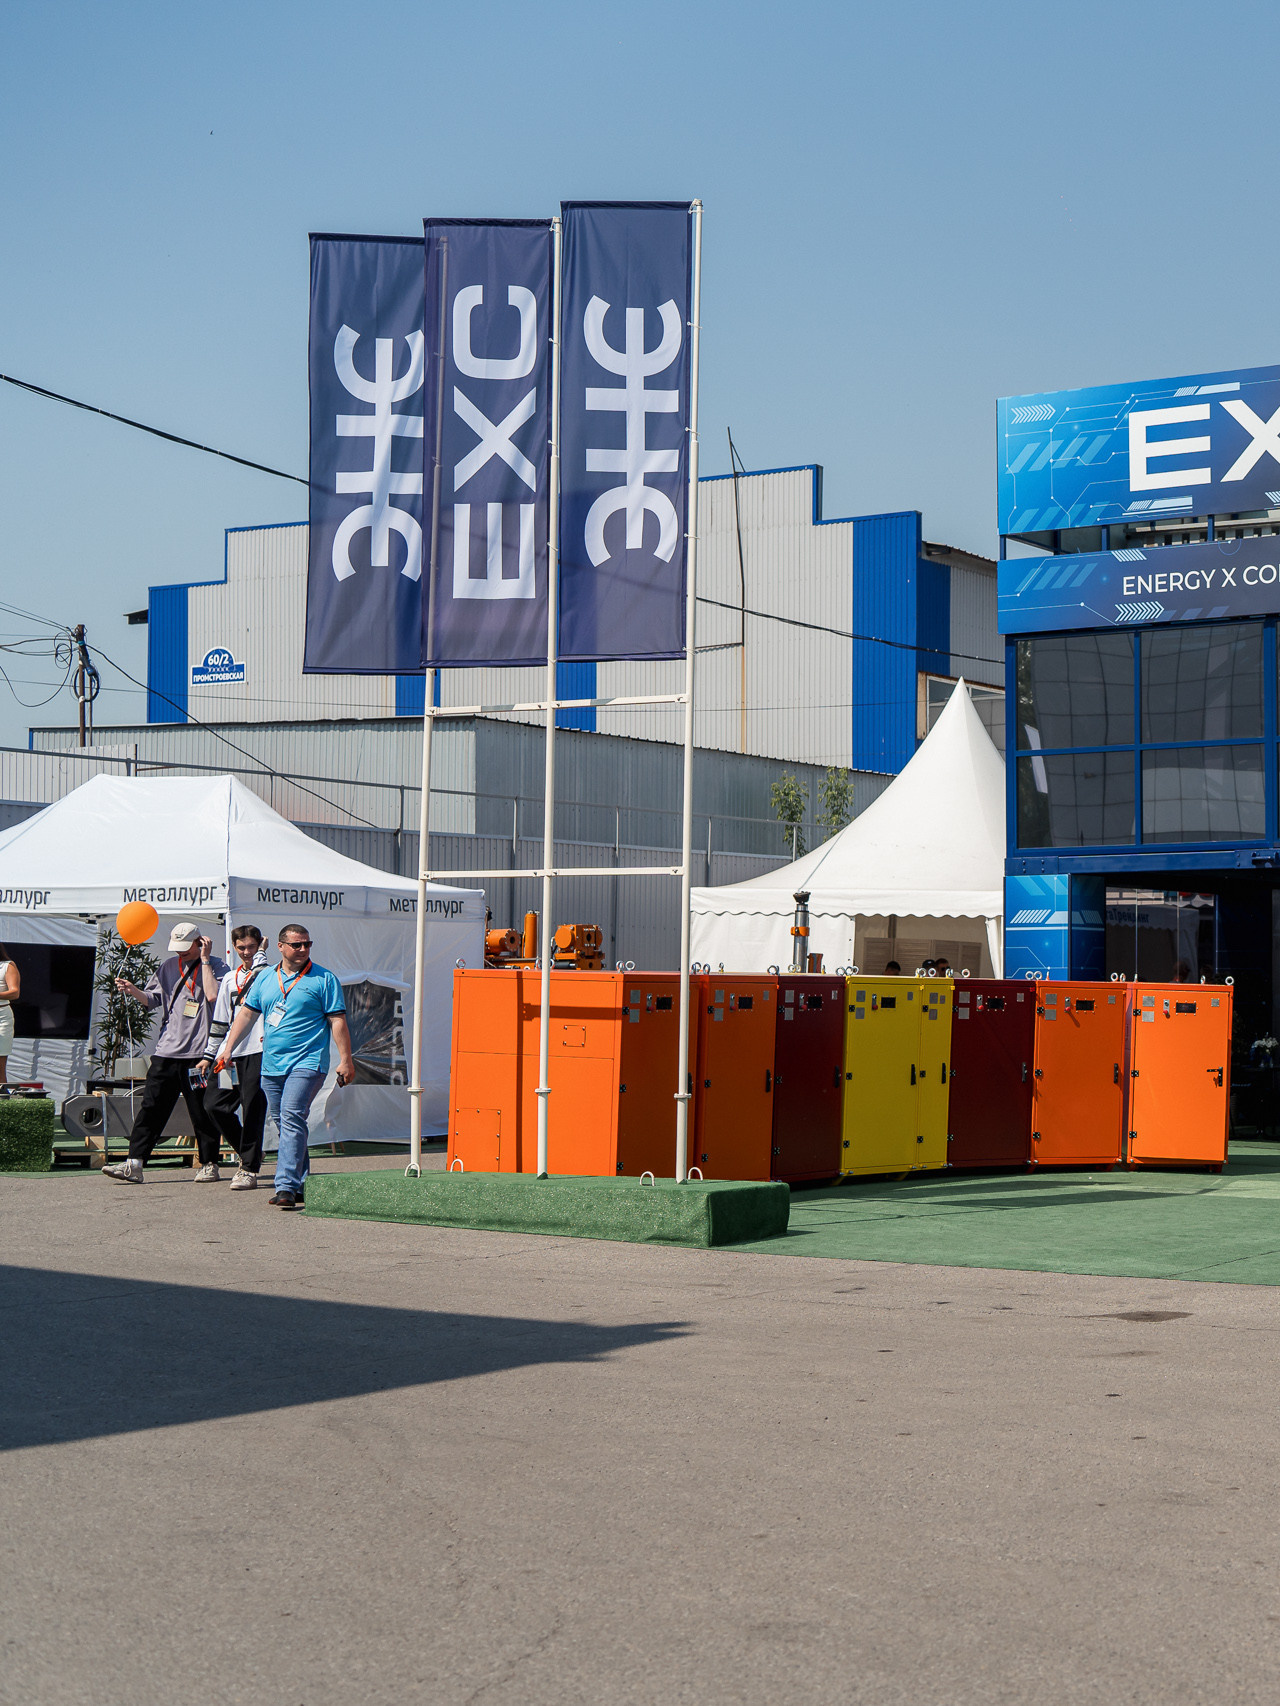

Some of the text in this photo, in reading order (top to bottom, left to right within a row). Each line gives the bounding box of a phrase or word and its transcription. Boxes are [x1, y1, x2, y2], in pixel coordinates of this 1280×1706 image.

[453, 285, 537, 599] EXC
[1122, 569, 1216, 596] ENERGY
[1221, 568, 1238, 588] X
[207, 653, 229, 666] 60/2
[193, 671, 244, 683] ПРОМСТРОЕВСКАЯ
[389, 897, 465, 919] метллург
